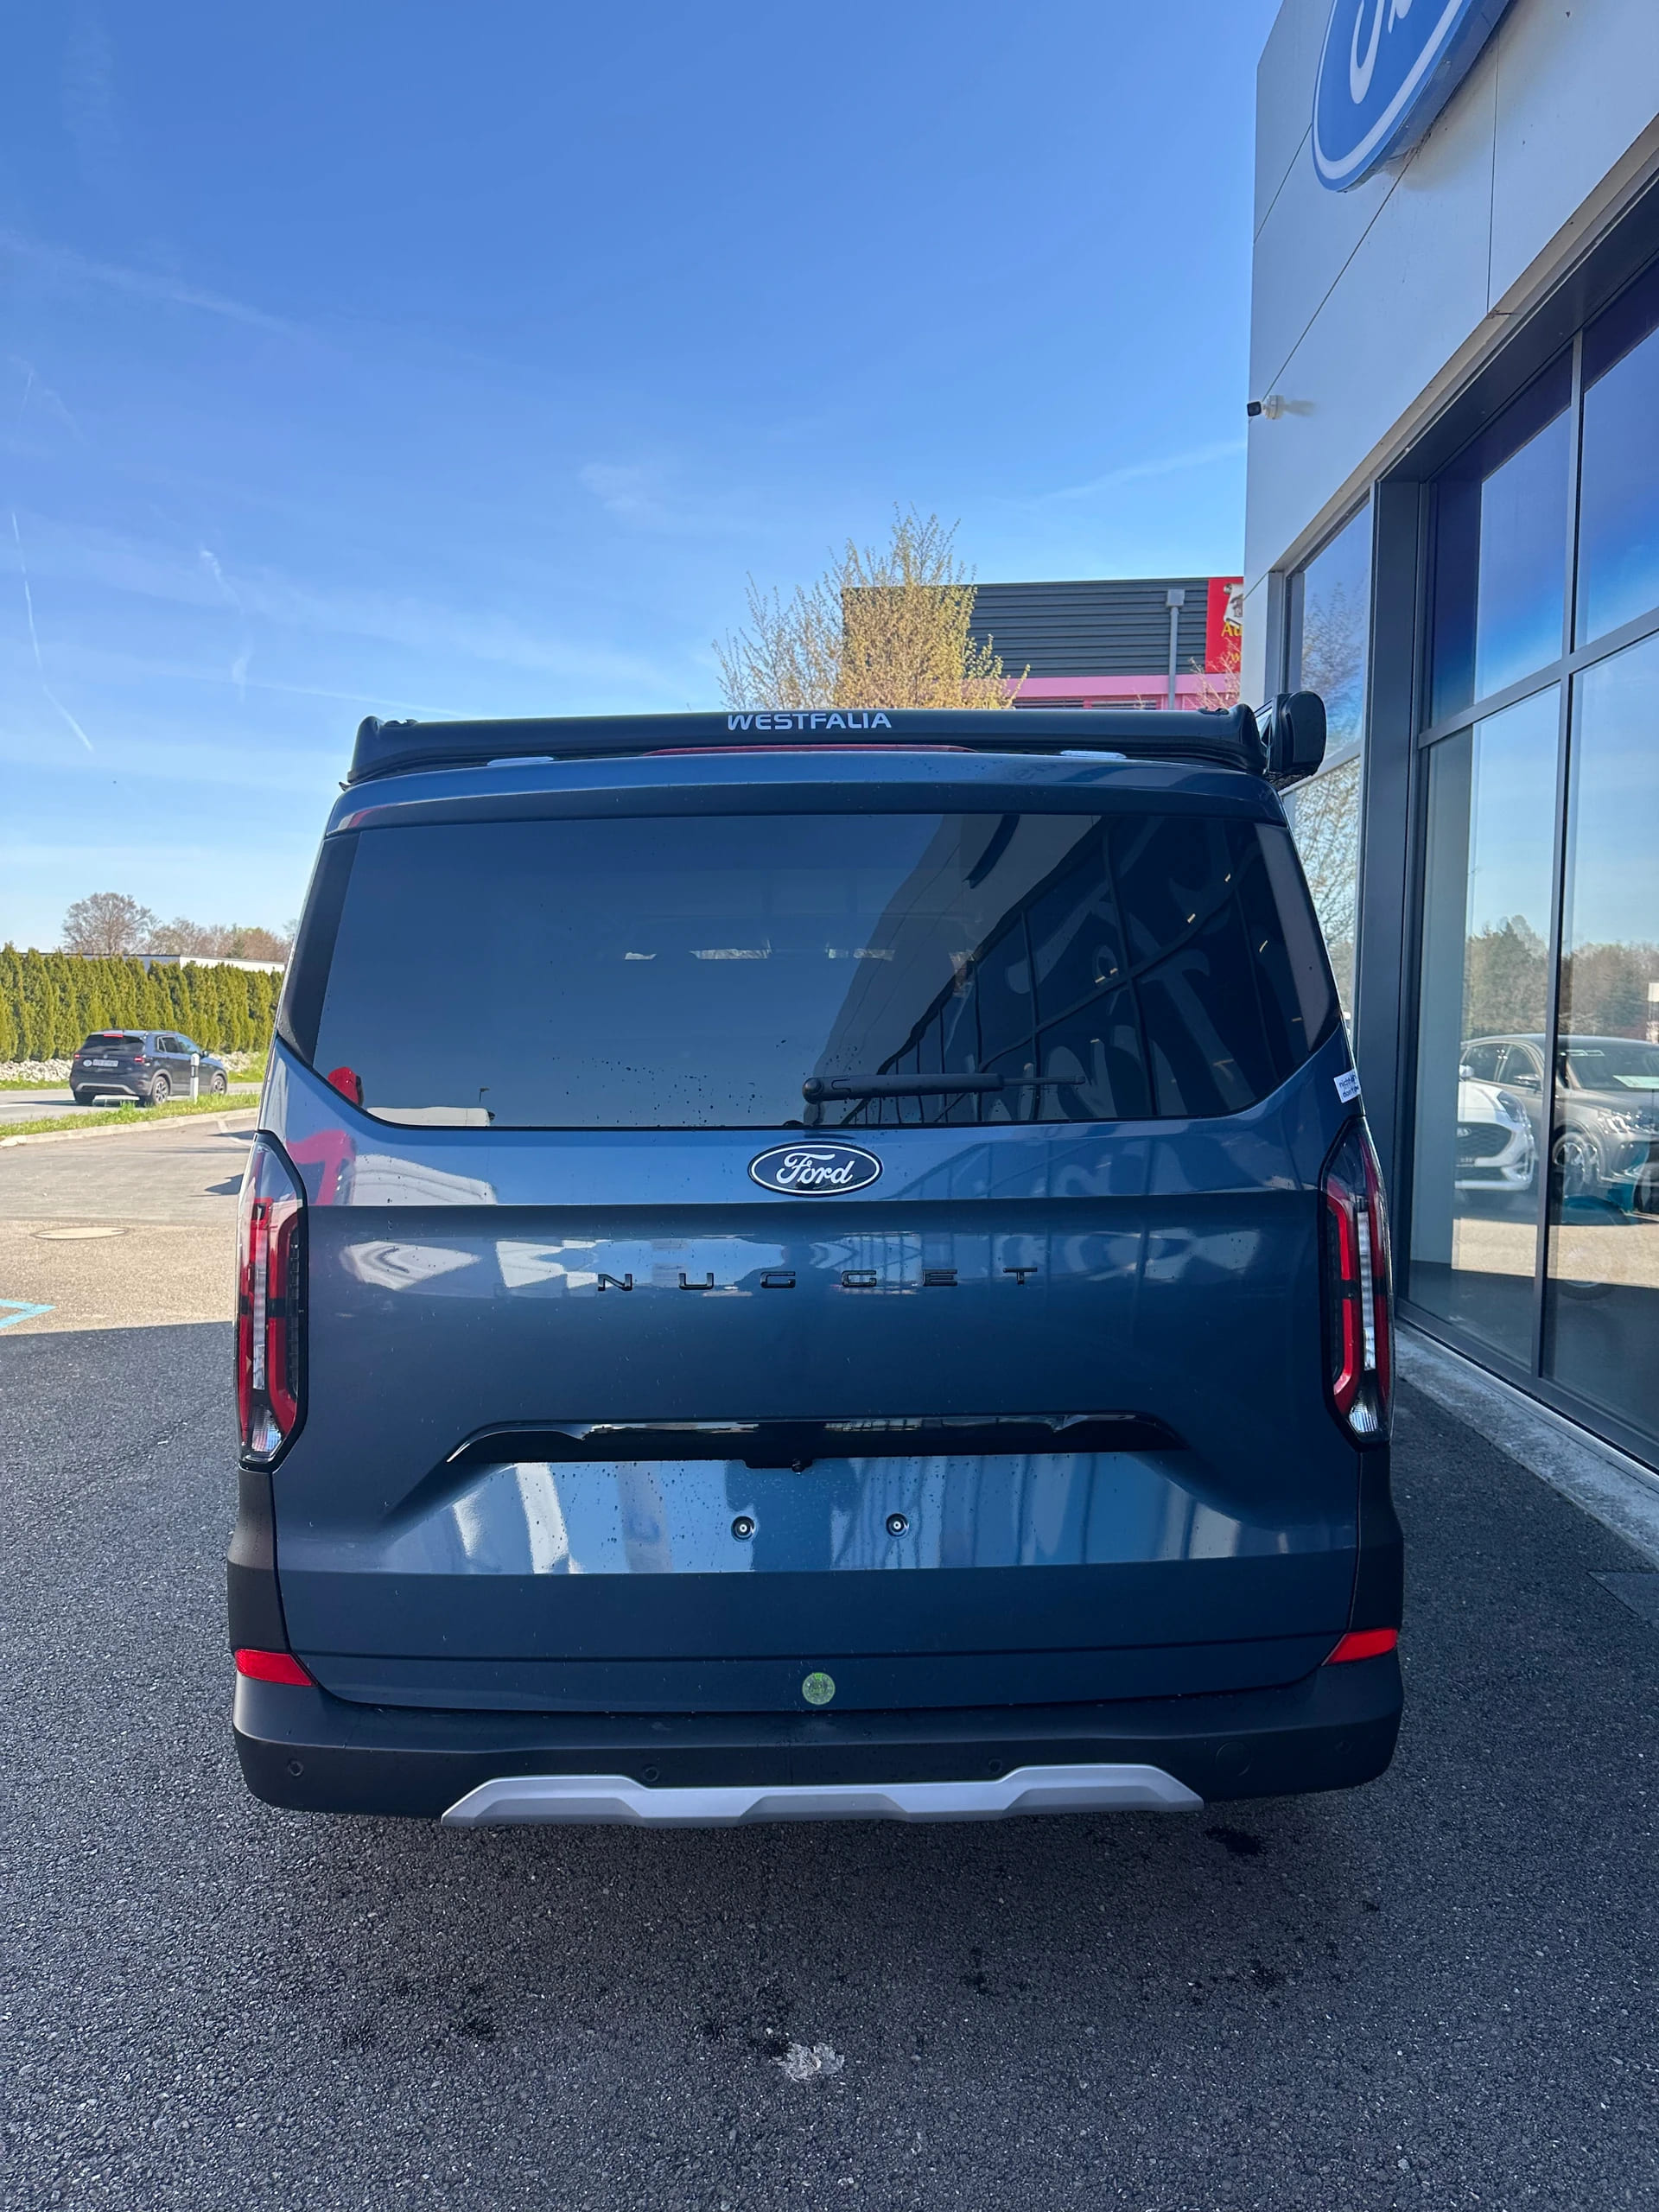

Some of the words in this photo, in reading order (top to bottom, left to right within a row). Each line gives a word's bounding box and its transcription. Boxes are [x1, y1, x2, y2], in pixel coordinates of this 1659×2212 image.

[728, 713, 892, 731] WESTFALIA
[776, 1152, 855, 1185] Ford
[598, 1267, 1038, 1292] NUGGET
